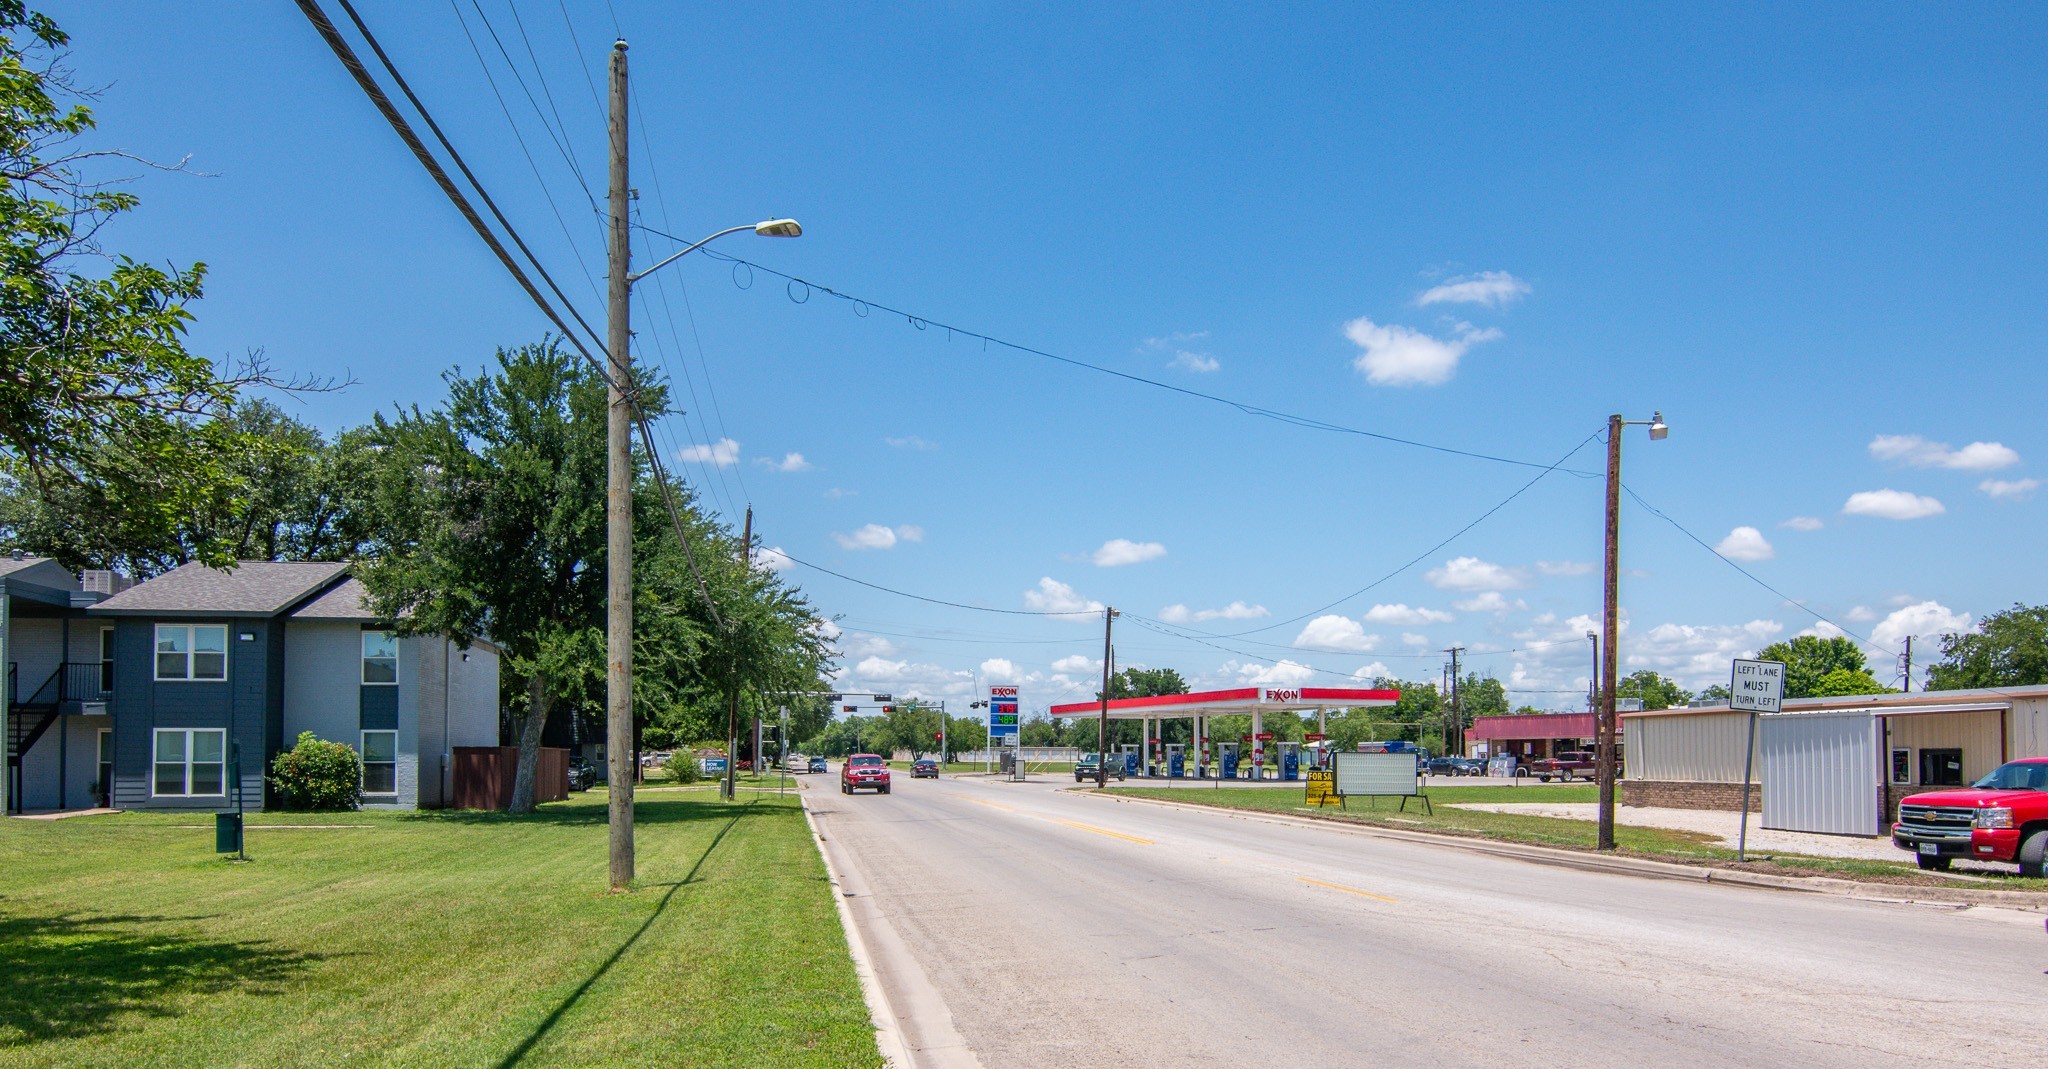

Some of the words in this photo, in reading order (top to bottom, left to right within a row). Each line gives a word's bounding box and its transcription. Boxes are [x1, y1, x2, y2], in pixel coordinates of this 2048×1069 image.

[1738, 666, 1755, 675] LEFT
[1759, 668, 1778, 677] LANE
[1744, 680, 1770, 692] MUST
[992, 688, 1017, 698] EXXON
[1266, 689, 1298, 702] EXXON
[1736, 695, 1755, 704] TURN
[1758, 697, 1776, 706] LEFT
[1308, 772, 1322, 781] FOR
[1323, 772, 1332, 781] SA
